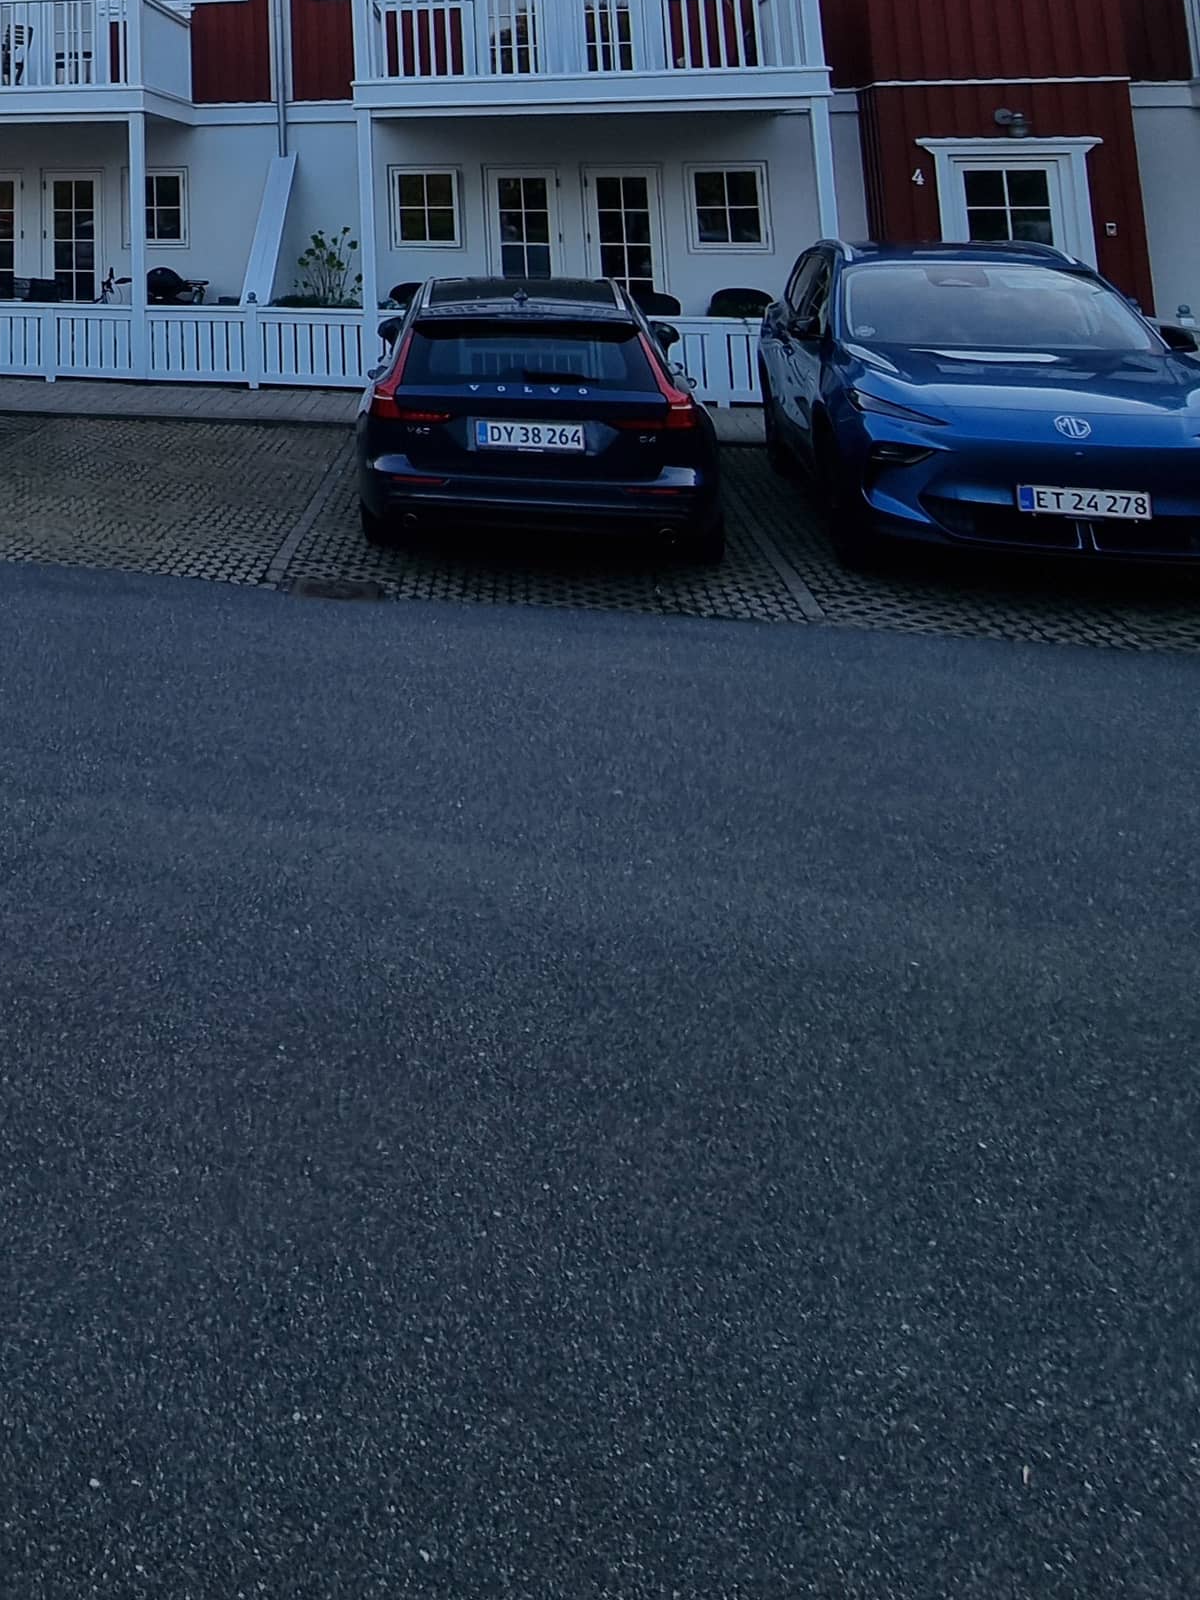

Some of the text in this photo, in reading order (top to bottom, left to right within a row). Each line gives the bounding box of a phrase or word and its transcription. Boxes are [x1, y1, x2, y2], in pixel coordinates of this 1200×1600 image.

[912, 169, 924, 185] 4
[469, 384, 588, 394] VOLVO
[490, 426, 514, 442] DY
[520, 427, 541, 444] 38
[547, 428, 581, 446] 264
[1057, 417, 1089, 437] MG
[1036, 491, 1147, 515] ET 24 278
